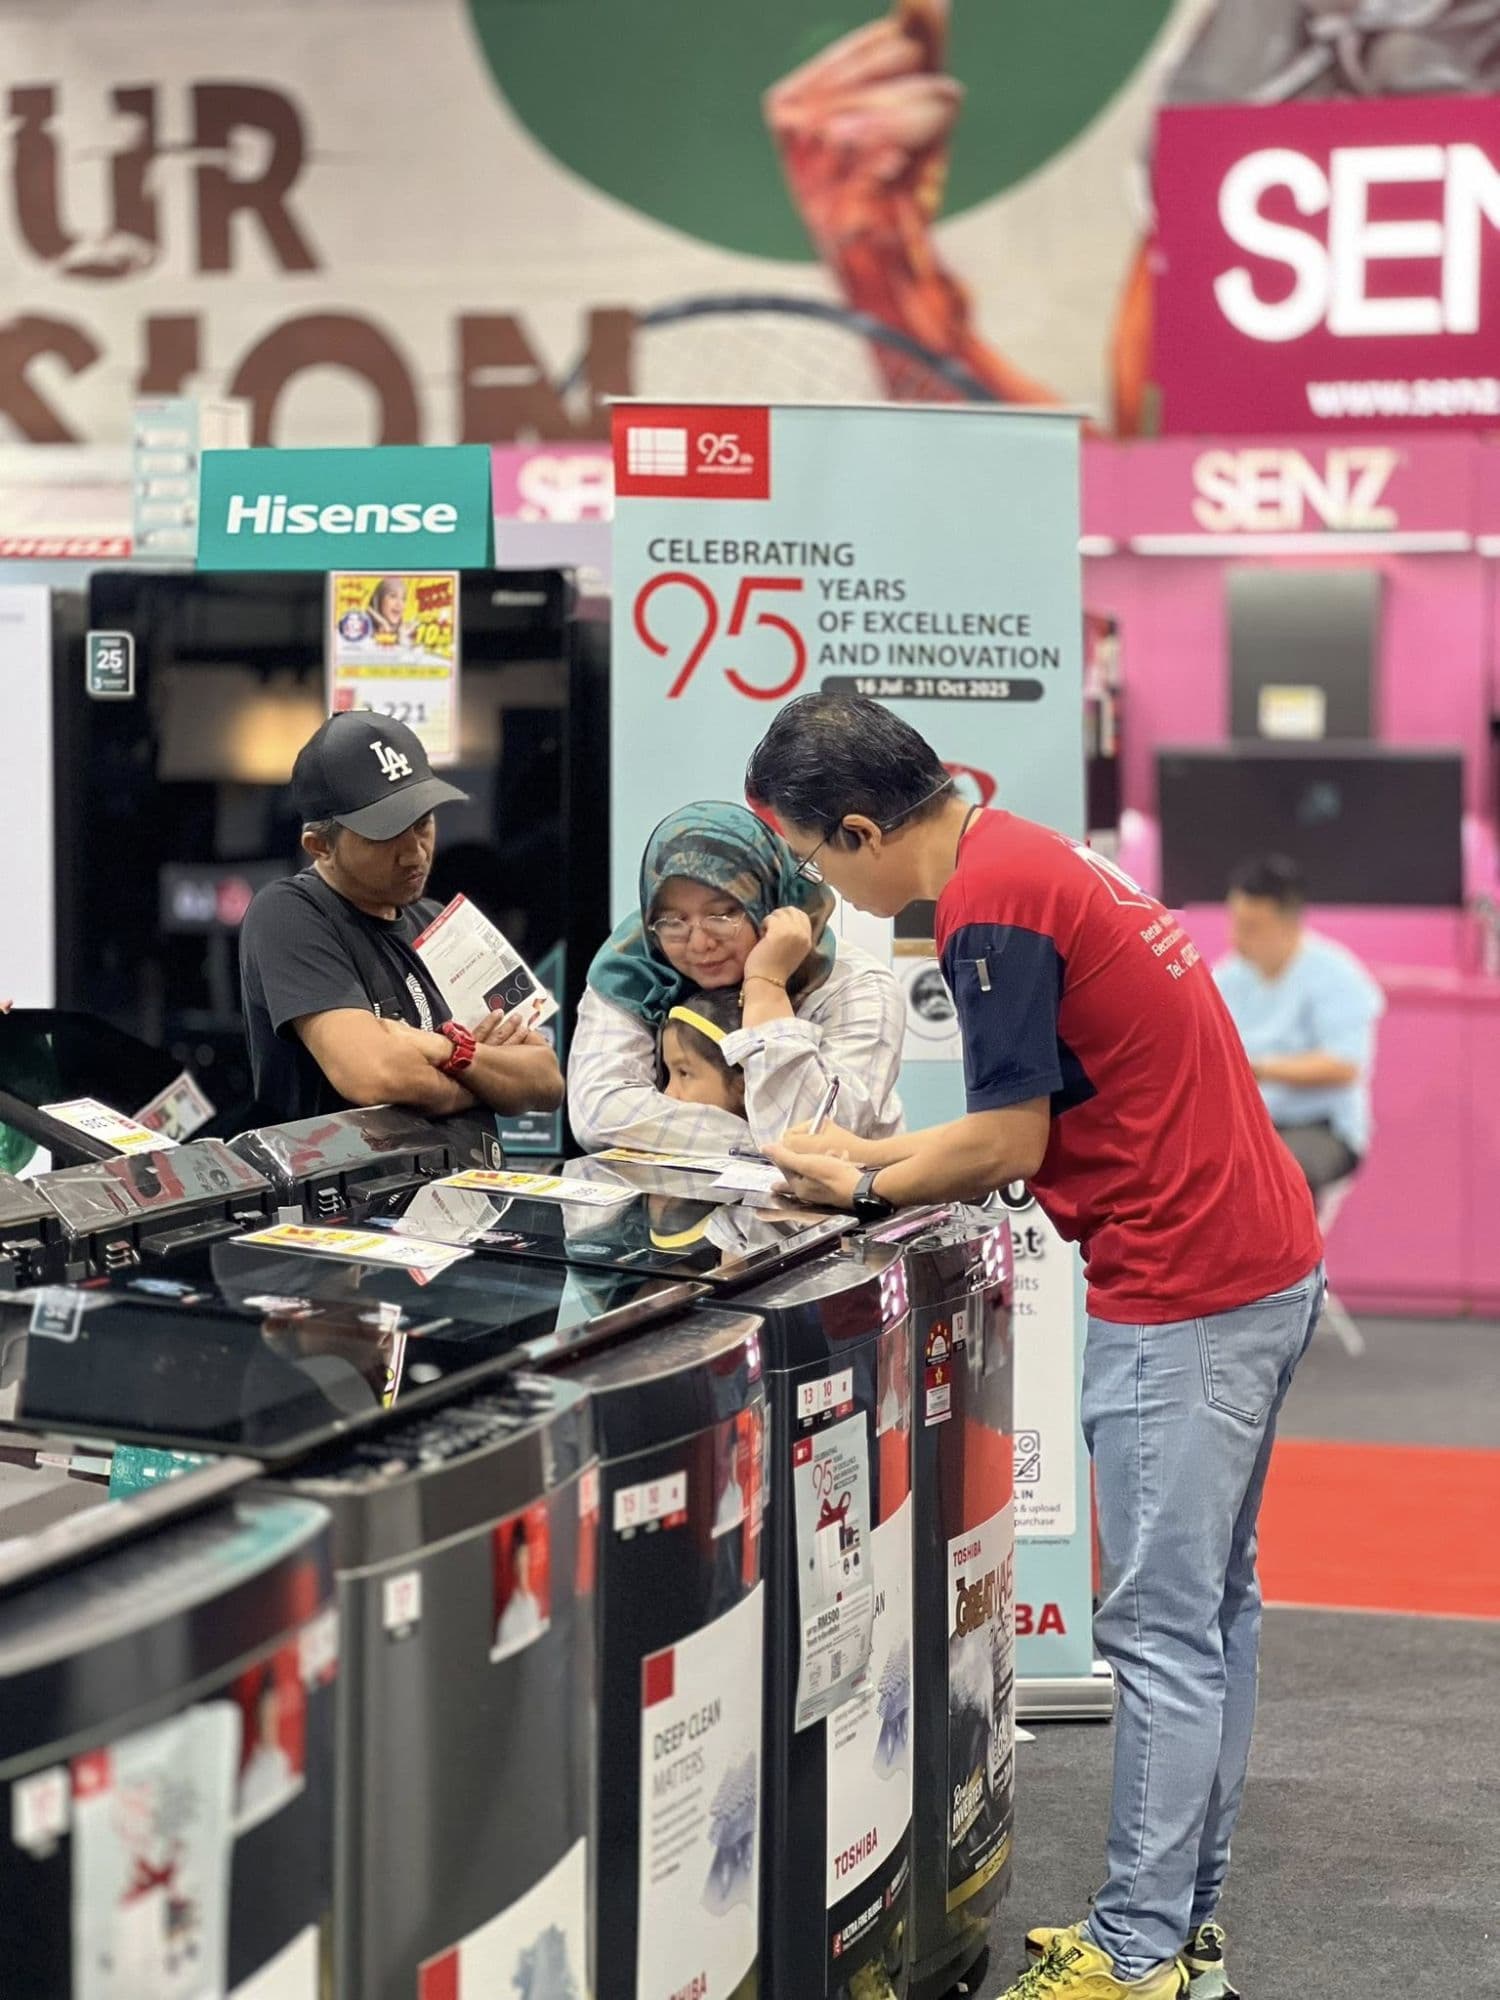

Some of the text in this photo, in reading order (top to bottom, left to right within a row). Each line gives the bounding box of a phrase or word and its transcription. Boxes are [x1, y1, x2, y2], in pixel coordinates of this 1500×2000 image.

[1190, 446, 1400, 533] SENZ
[226, 495, 458, 534] Hisense
[647, 538, 855, 568] CELEBRATING
[818, 579, 907, 602] YEARS
[633, 571, 807, 701] 95
[818, 611, 1031, 638] OF EXCELLENCE
[96, 649, 122, 670] 25
[817, 643, 1060, 670] AND INNOVATION
[914, 680, 934, 696] 31
[937, 681, 966, 696] Oct
[369, 741, 413, 781] LA
[812, 1459, 833, 1499] 95
[953, 1540, 981, 1567] TOSHIBA
[653, 1697, 721, 1761] DEEP CLEAN
[834, 1826, 878, 1880] TOSHIBA
